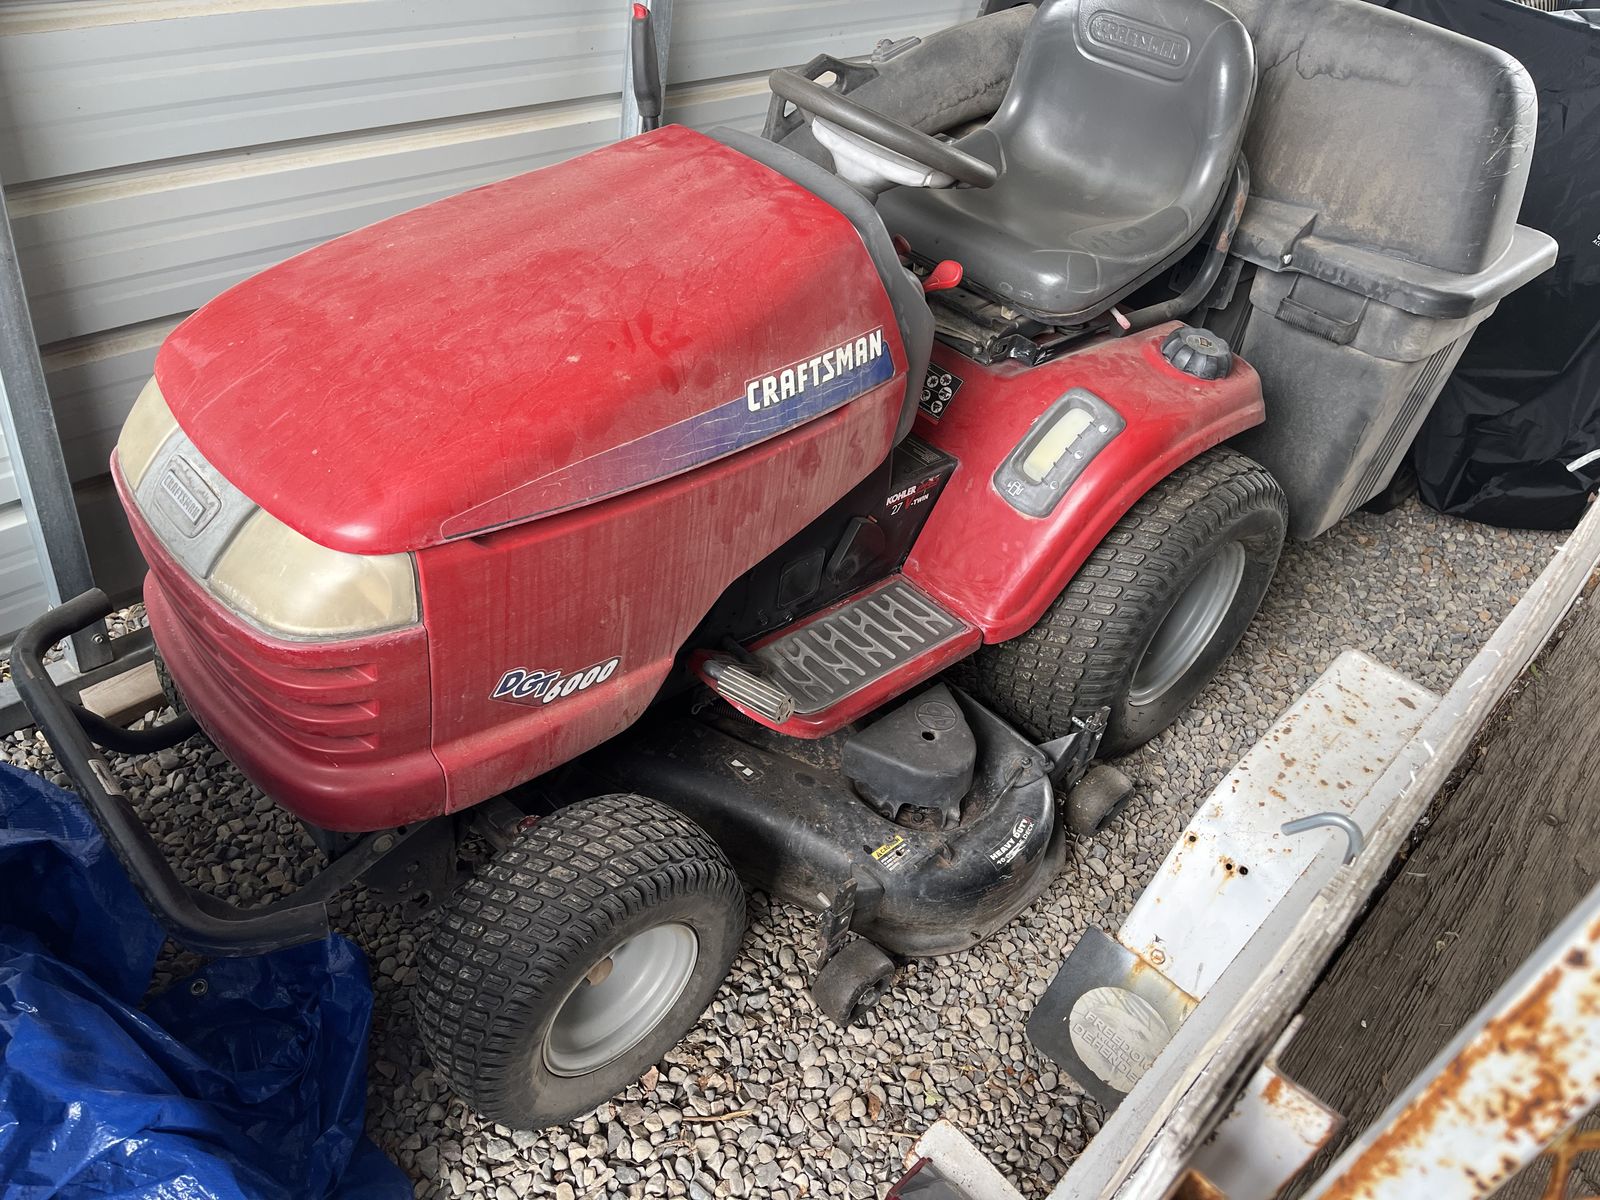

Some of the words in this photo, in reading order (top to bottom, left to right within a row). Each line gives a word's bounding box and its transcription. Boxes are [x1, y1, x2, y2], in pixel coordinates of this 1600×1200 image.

[747, 329, 882, 411] CRAFTSMAN
[163, 474, 201, 520] CRAFTSMAN
[886, 485, 917, 506] KOHLER
[890, 502, 903, 515] 27
[990, 838, 1015, 860] HEAVY
[1013, 818, 1028, 839] DUTY
[1071, 1022, 1142, 1085] DEFENDE
